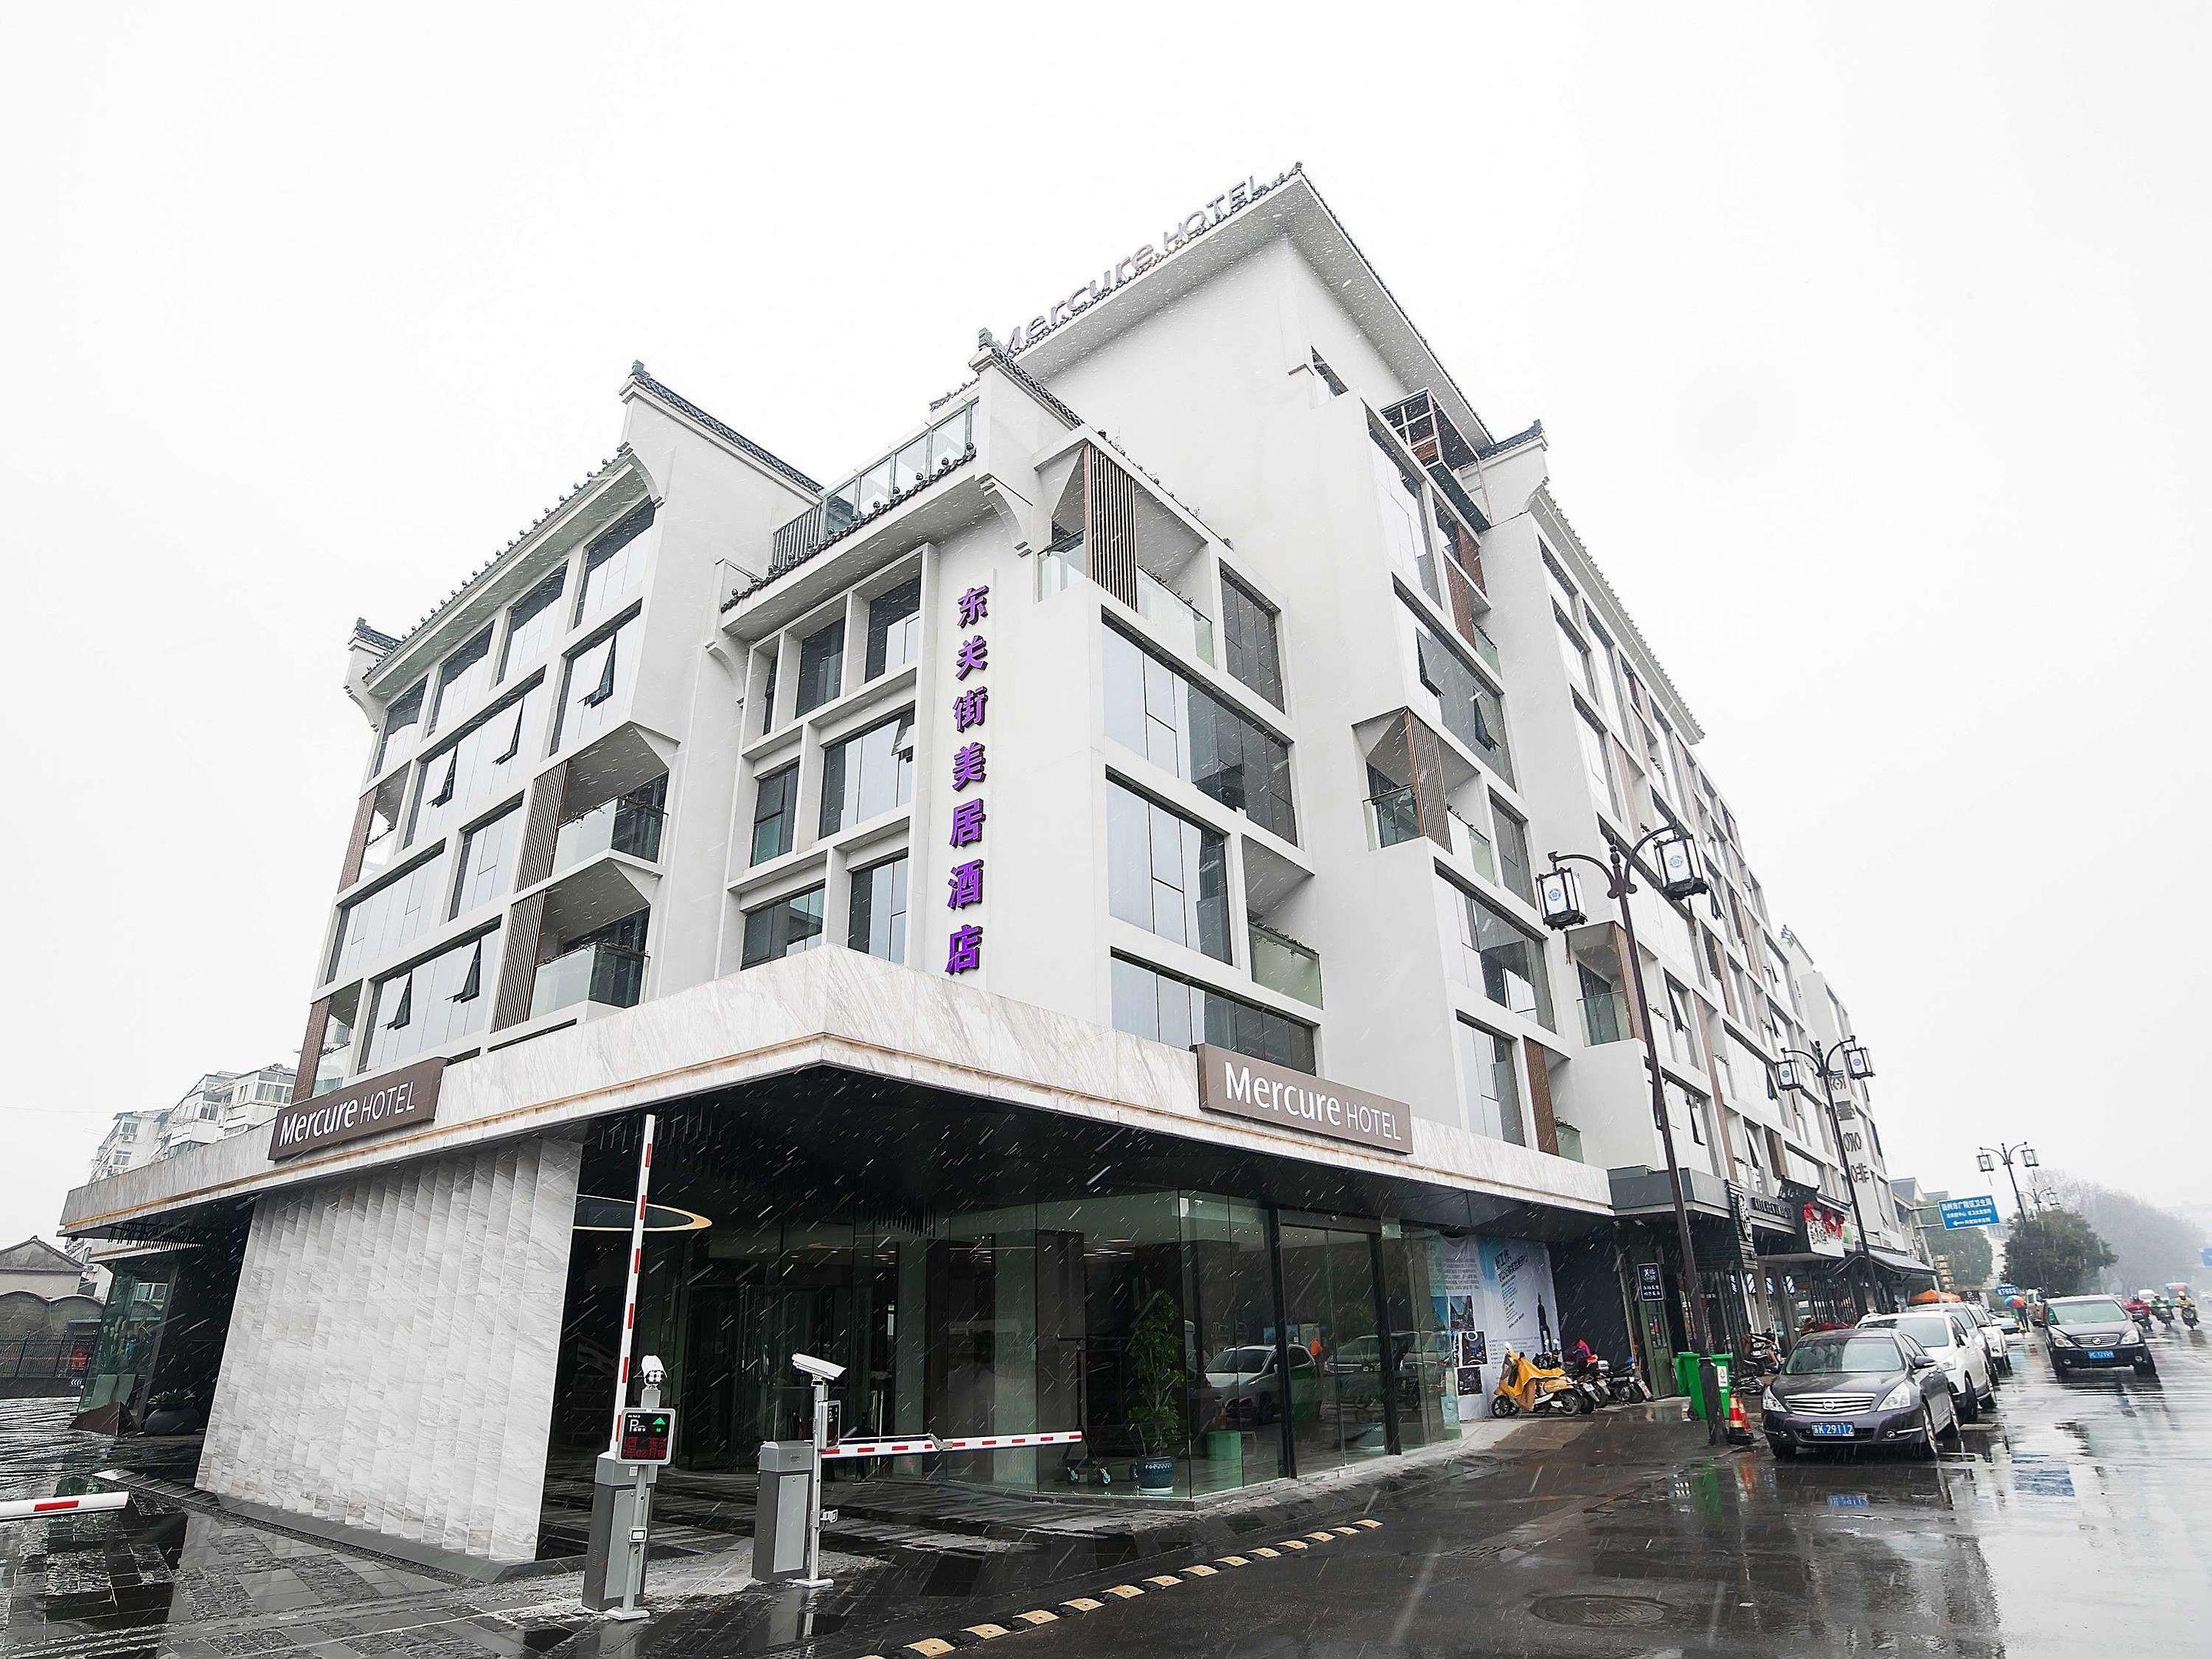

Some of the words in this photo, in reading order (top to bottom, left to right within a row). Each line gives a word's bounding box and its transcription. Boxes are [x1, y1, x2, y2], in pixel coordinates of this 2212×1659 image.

[1164, 175, 1270, 251] HOTEL
[945, 584, 988, 974] 东关街美居酒店
[278, 1098, 359, 1147] Mercure
[359, 1081, 416, 1124] HOTEL
[1224, 1061, 1342, 1126] Mercure
[1346, 1101, 1402, 1141] HOTEL
